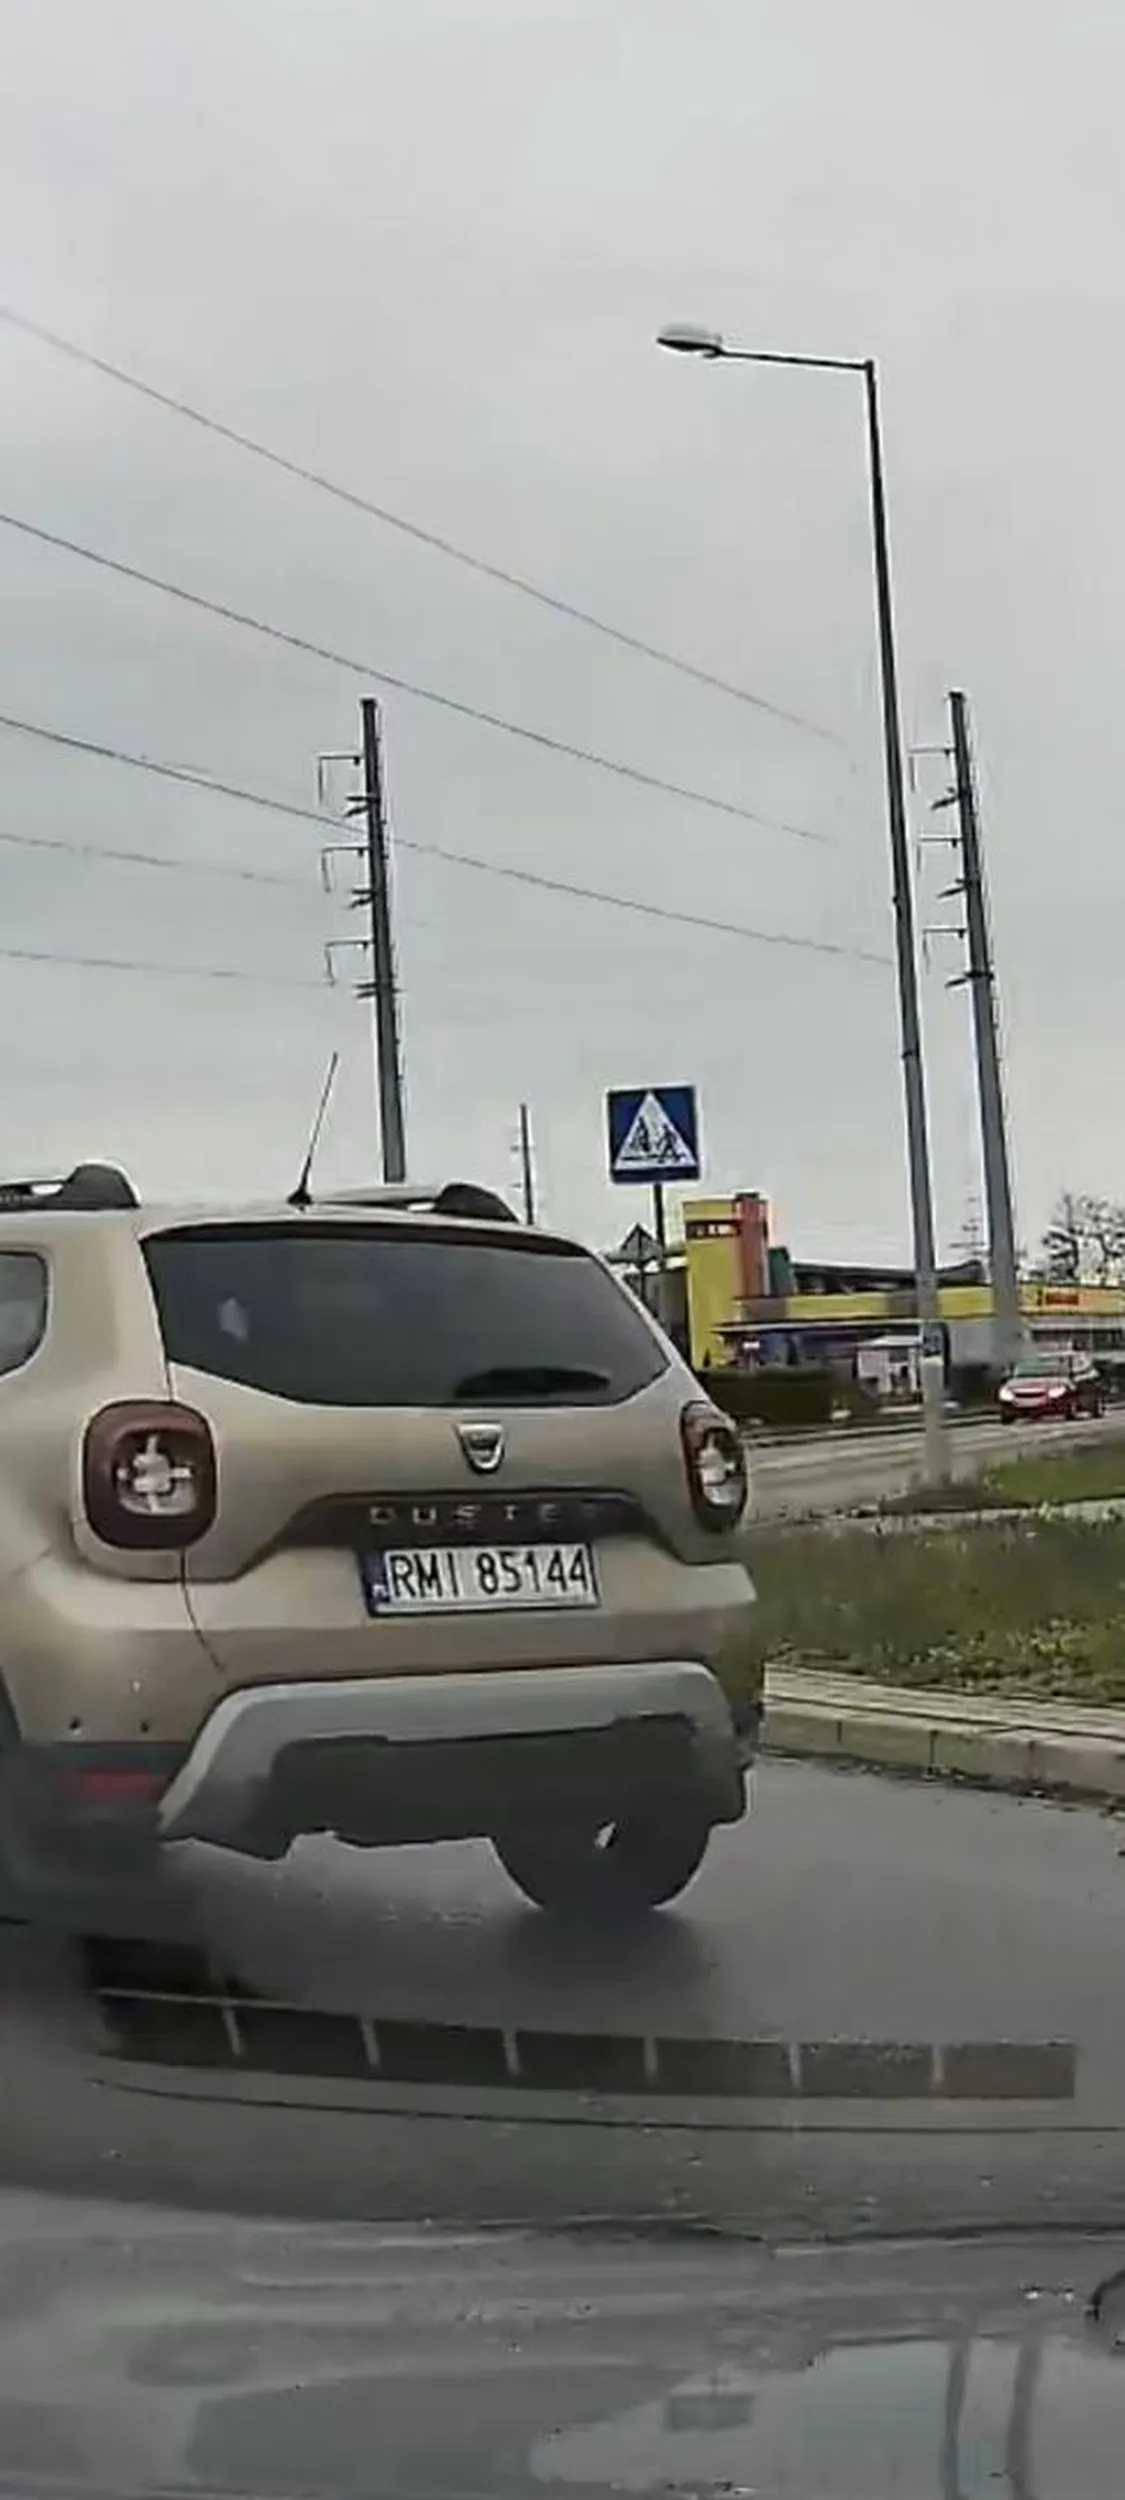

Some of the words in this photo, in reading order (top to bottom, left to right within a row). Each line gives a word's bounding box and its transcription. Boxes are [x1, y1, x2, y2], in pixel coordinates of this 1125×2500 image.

[370, 1504, 597, 1527] DUSTE
[389, 1552, 459, 1597] RMI
[476, 1549, 589, 1595] 85144
